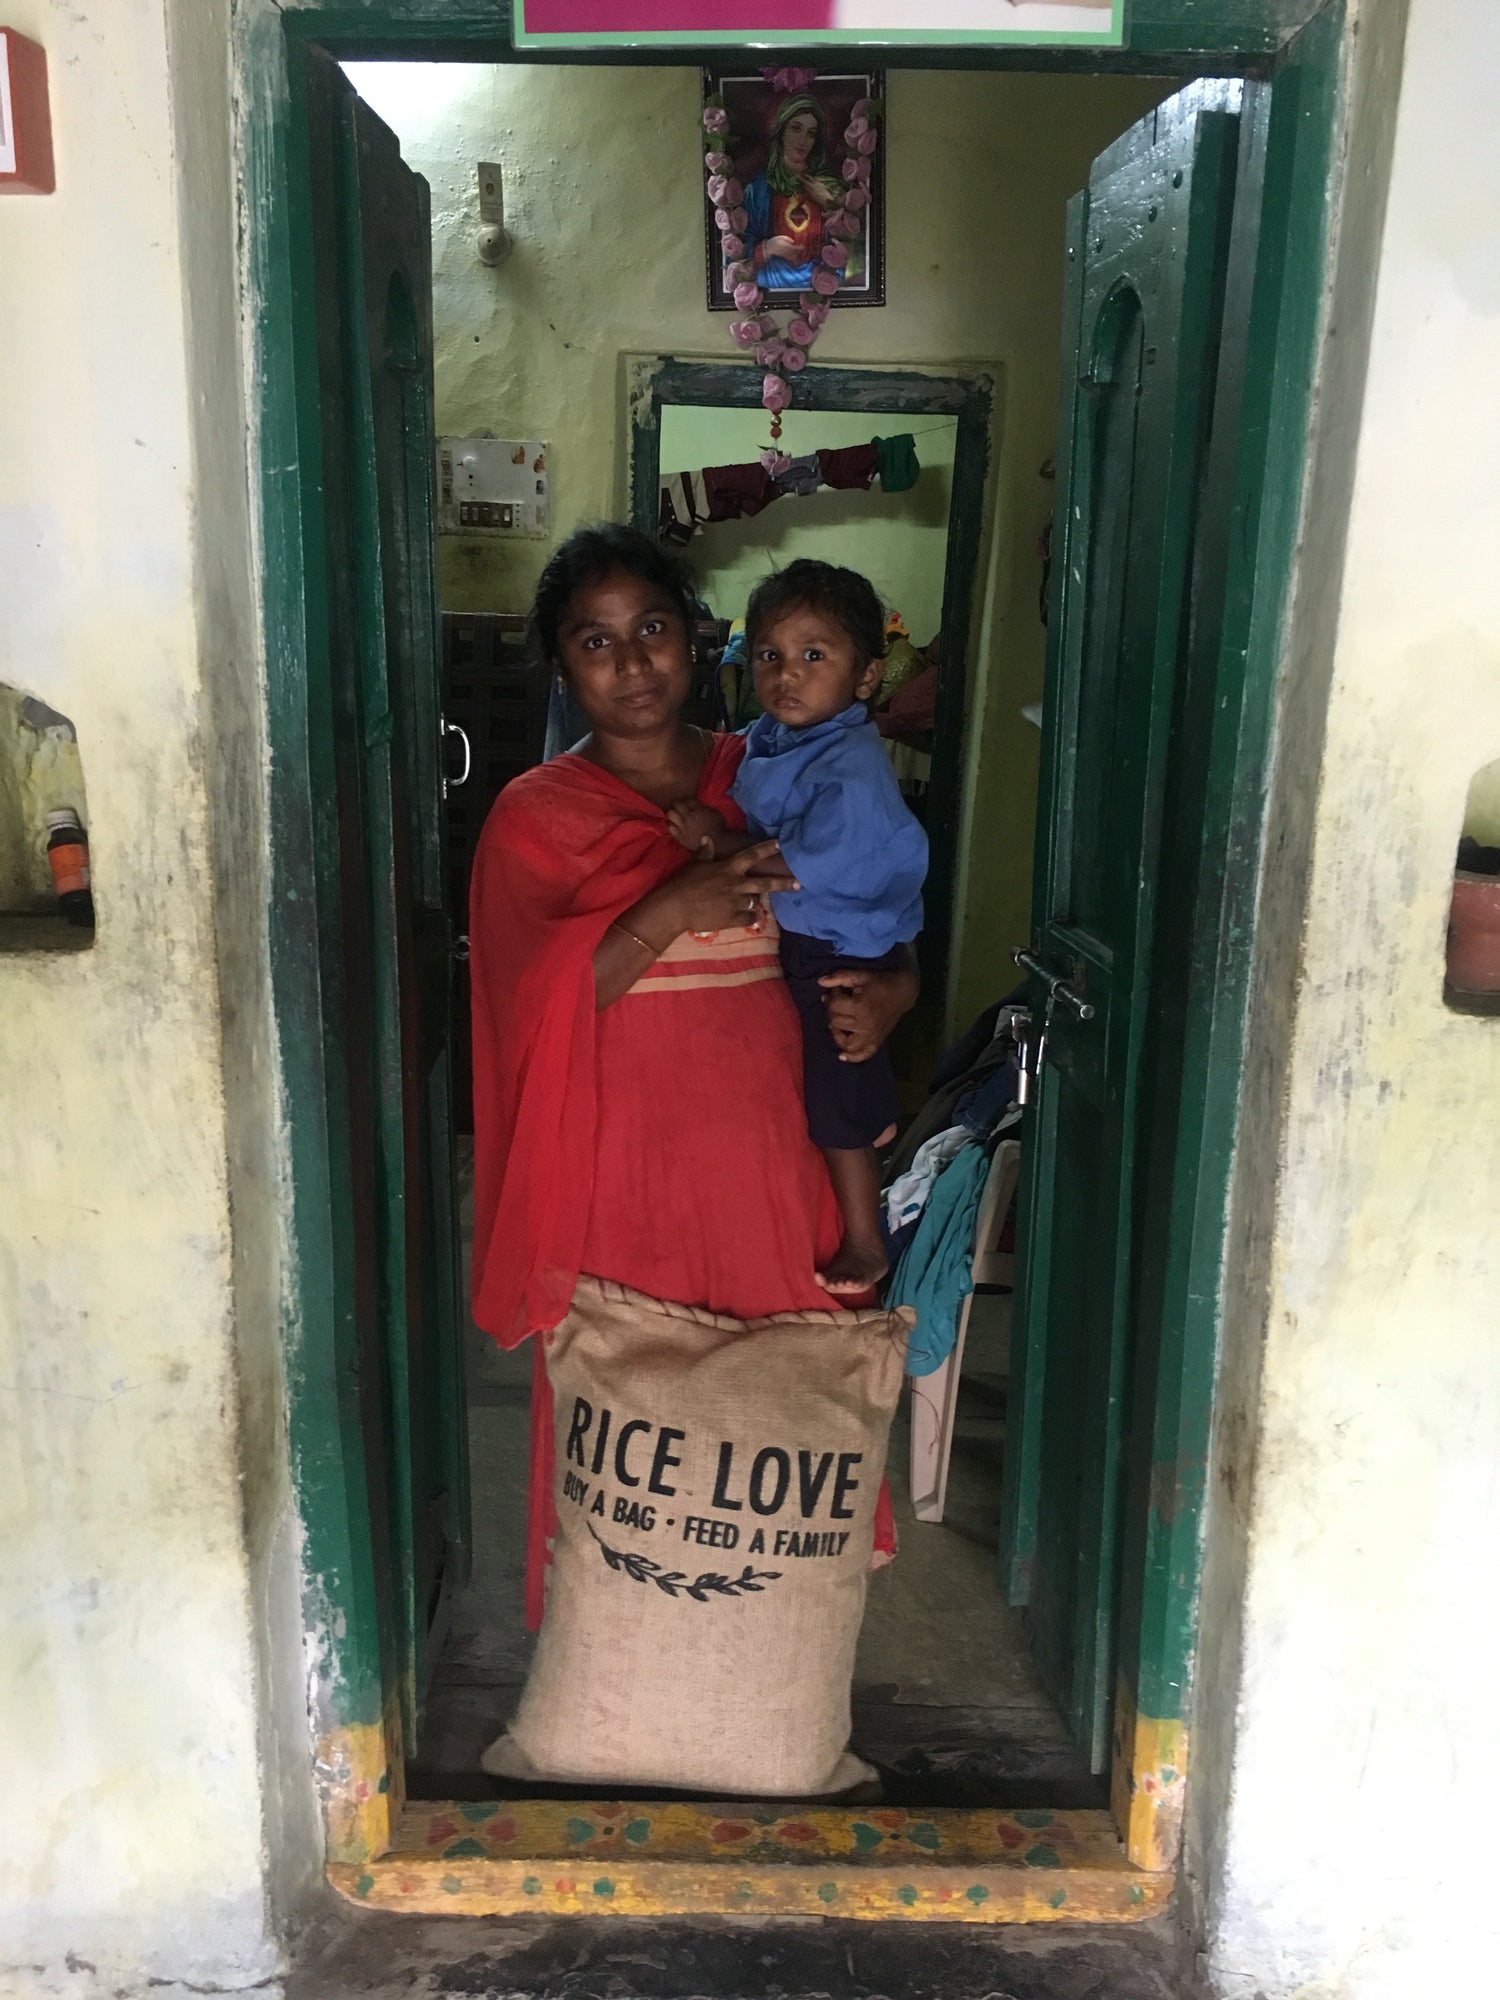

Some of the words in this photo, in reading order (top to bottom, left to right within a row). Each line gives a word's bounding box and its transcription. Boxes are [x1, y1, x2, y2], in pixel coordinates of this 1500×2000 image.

[567, 1397, 686, 1496] RICE
[712, 1441, 863, 1519] LOVE
[563, 1470, 589, 1507] BUY
[590, 1489, 605, 1517] A
[612, 1496, 657, 1532] BAG
[682, 1515, 740, 1550] FEED
[748, 1527, 765, 1555] A
[773, 1529, 850, 1558] FAMILY
